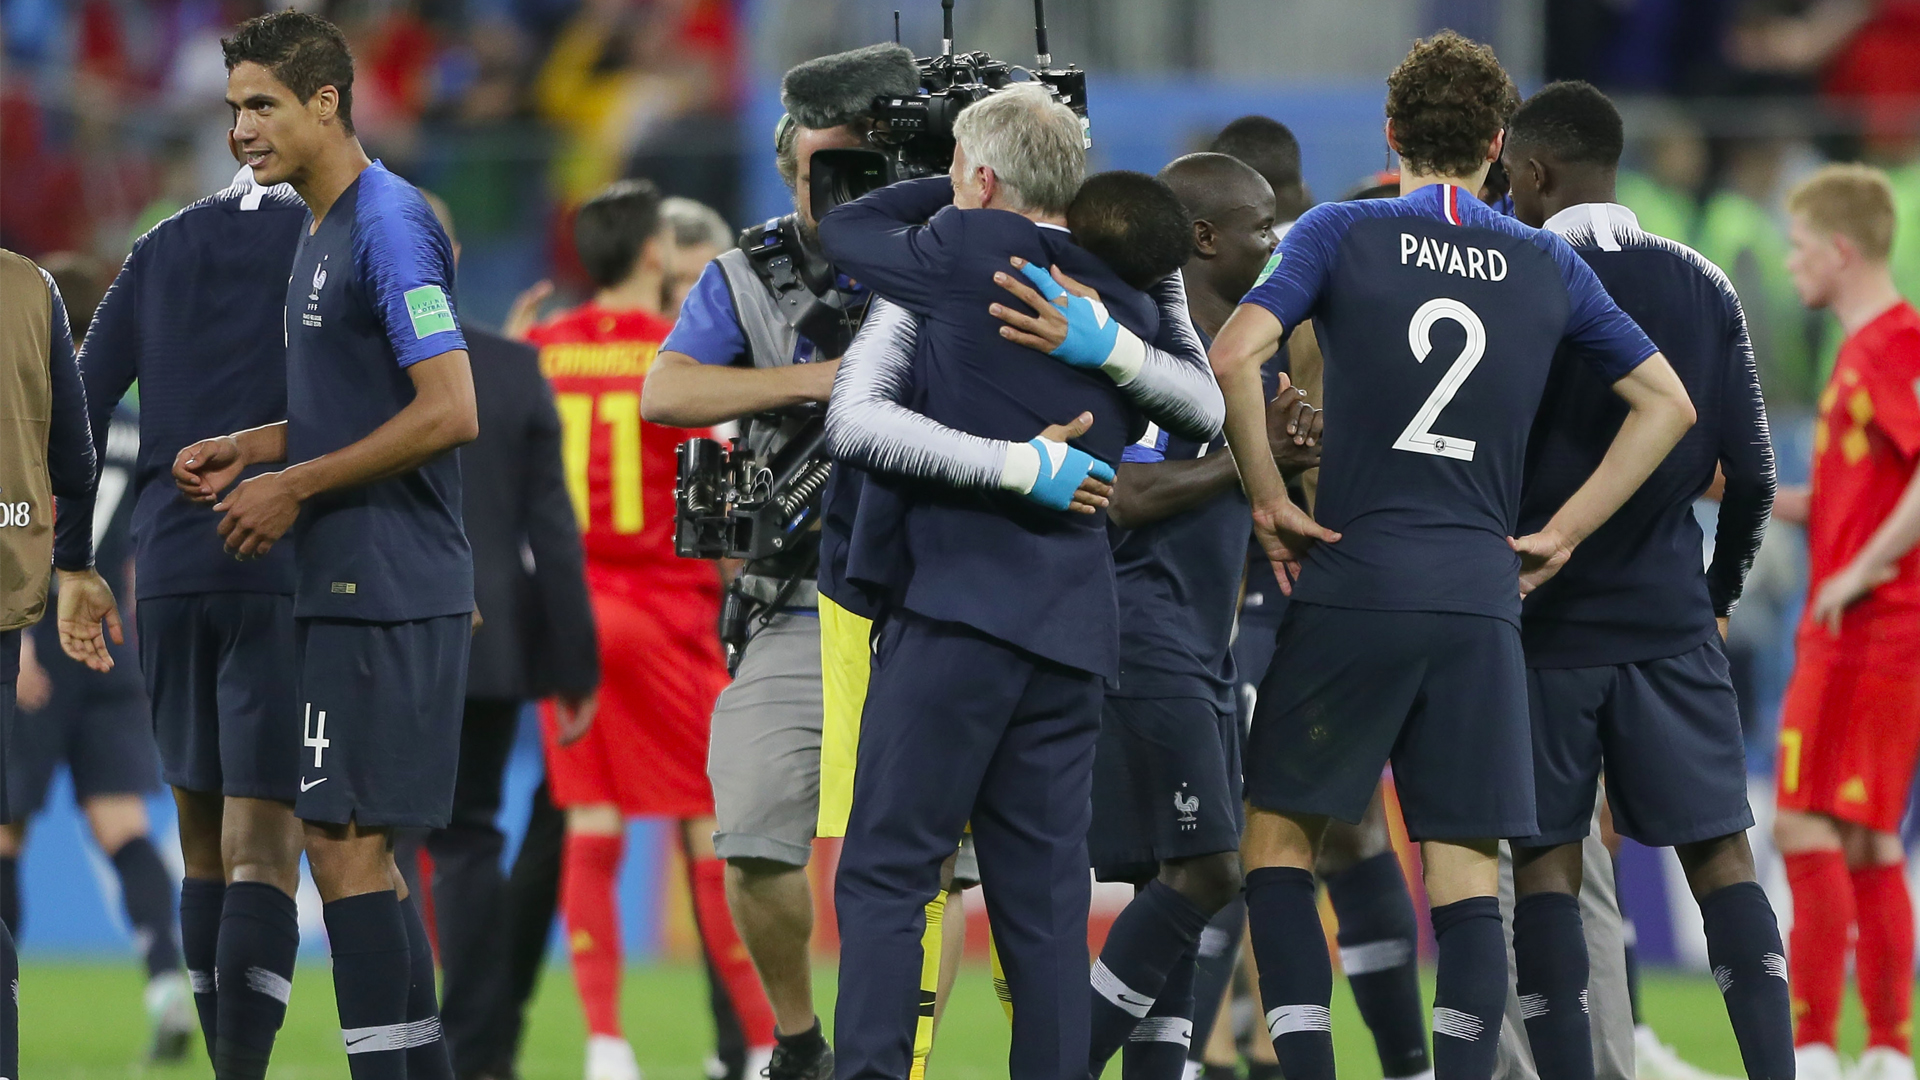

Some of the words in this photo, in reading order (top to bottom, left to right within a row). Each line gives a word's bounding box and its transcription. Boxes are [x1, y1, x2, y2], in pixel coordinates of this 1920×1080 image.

[1400, 233, 1508, 282] PAVARD
[1391, 298, 1487, 462] 2
[556, 391, 644, 534] 11
[304, 702, 330, 768] 4
